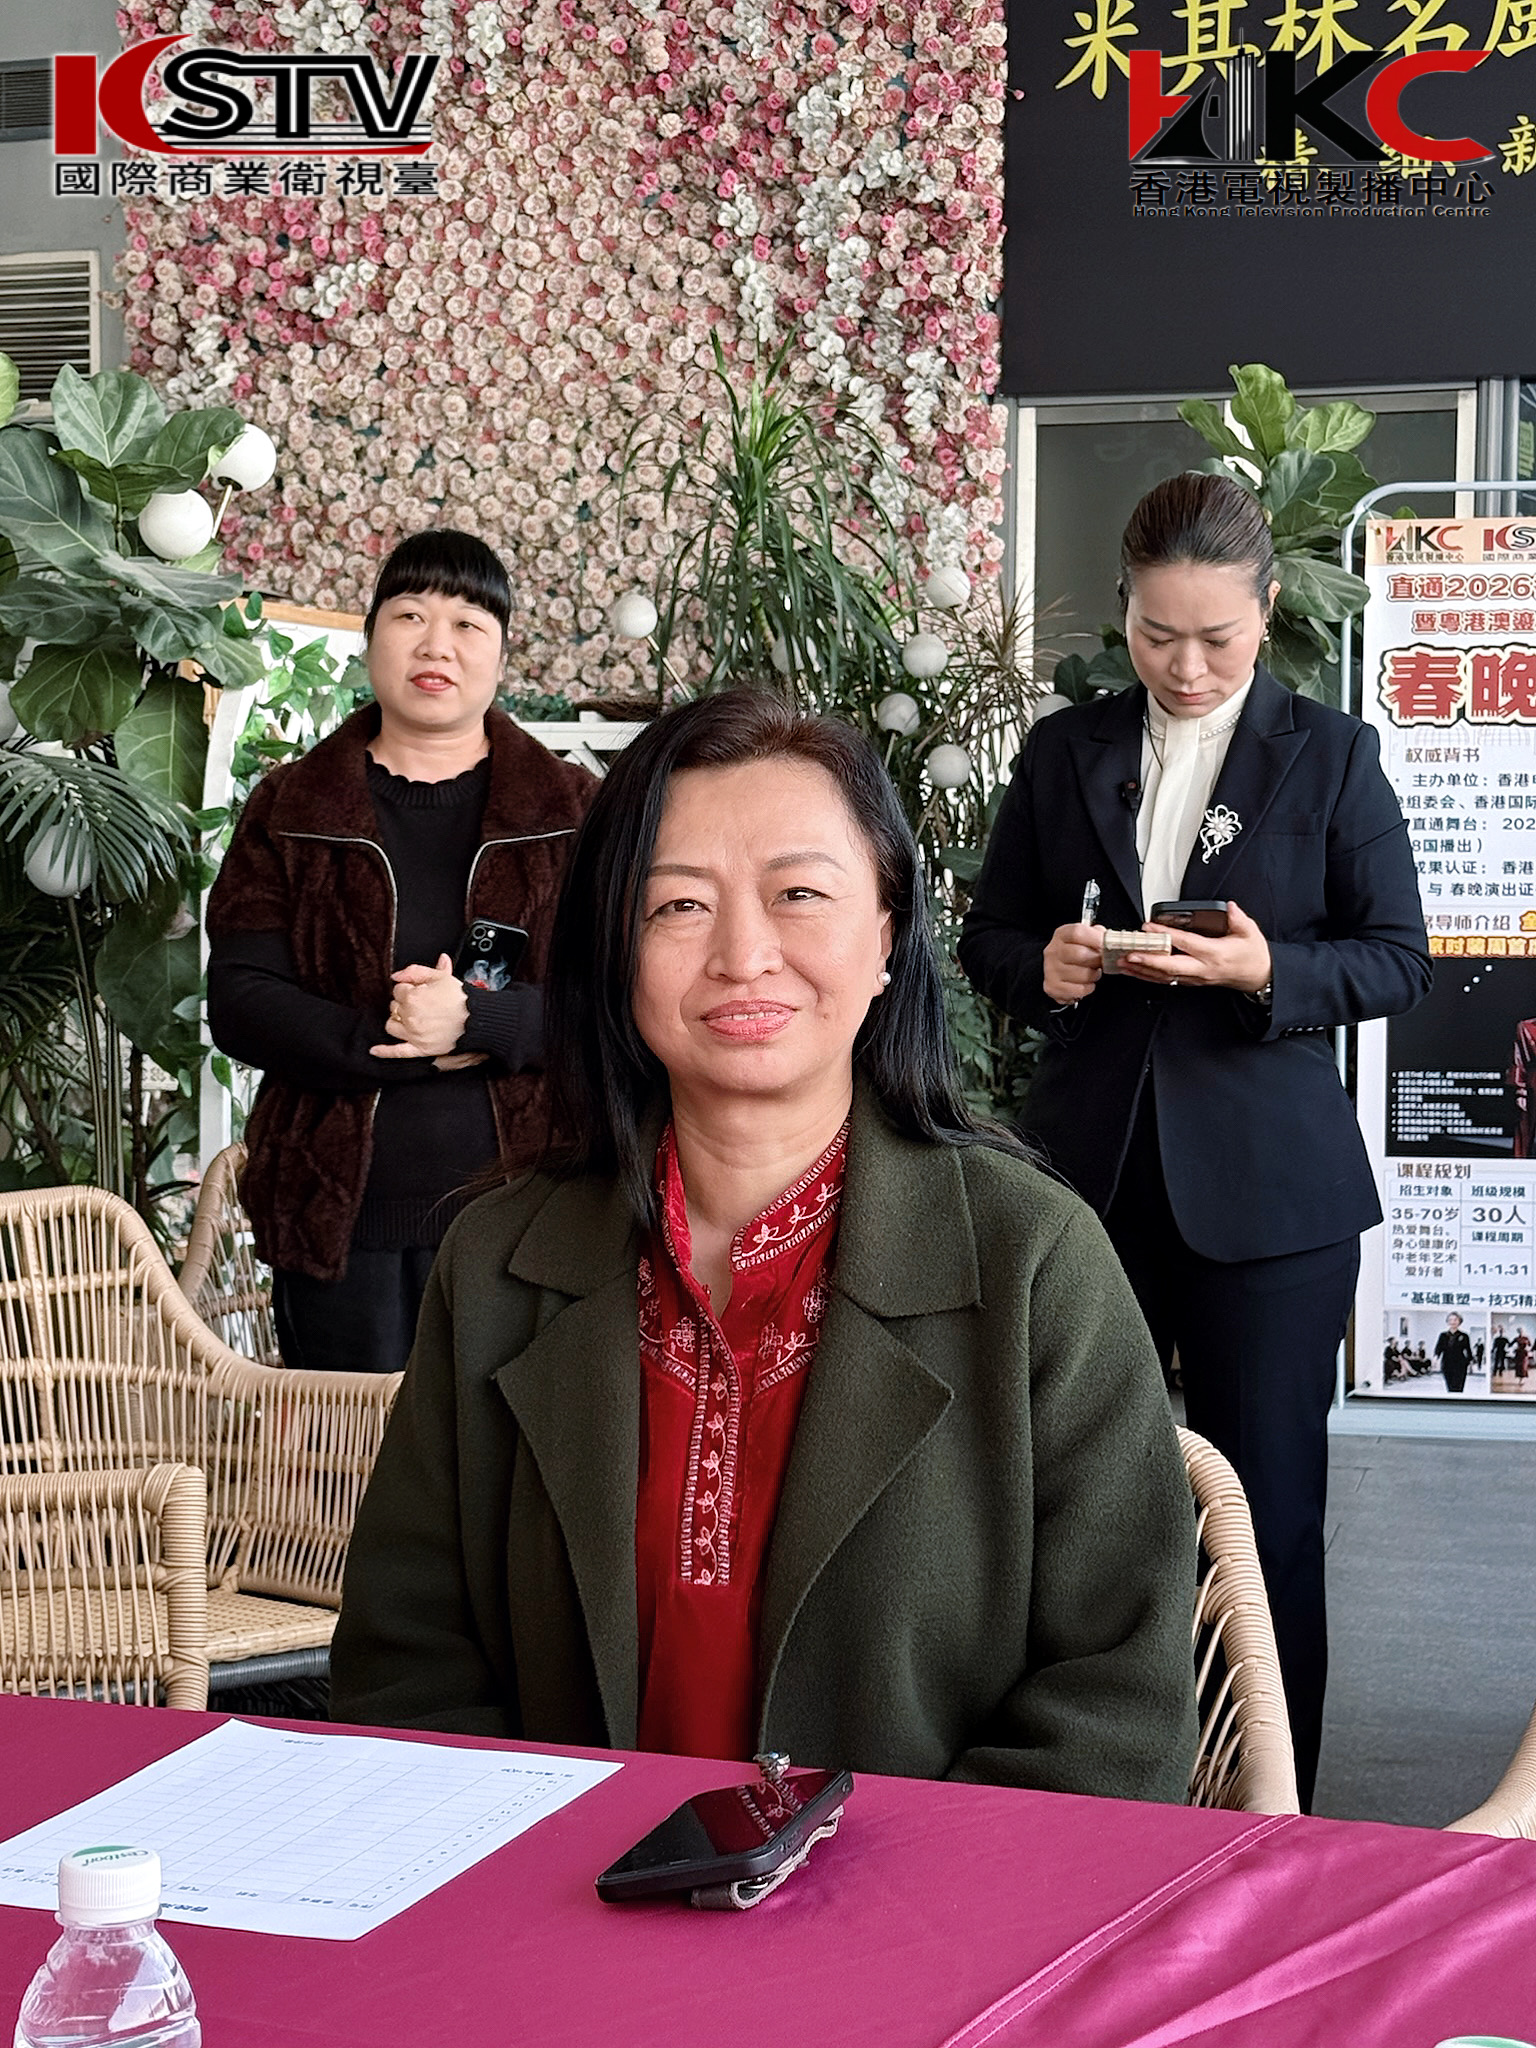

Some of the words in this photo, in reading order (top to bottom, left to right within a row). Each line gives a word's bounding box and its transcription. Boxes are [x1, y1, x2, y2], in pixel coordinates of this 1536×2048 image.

[1389, 575, 1536, 599] 直通2026
[1385, 651, 1536, 720] 春晚
[1405, 747, 1480, 763] 权威背书
[1412, 773, 1536, 788] 主办单位：香港
[1502, 861, 1534, 875] 香港
[1450, 882, 1536, 897] 春晚演出证
[1396, 1162, 1472, 1180] 课程规划
[1399, 1184, 1453, 1197] 招生对象
[1471, 1184, 1526, 1198] 班级规模
[1391, 1206, 1460, 1222] 35-70岁
[1471, 1204, 1527, 1225] 30人
[1392, 1237, 1458, 1250] 身心健康的
[1472, 1231, 1524, 1243] 课程周期
[1392, 1252, 1458, 1264] 中老年艺术
[1405, 1266, 1444, 1277] 爱好者
[1488, 1293, 1536, 1308] 技巧精
